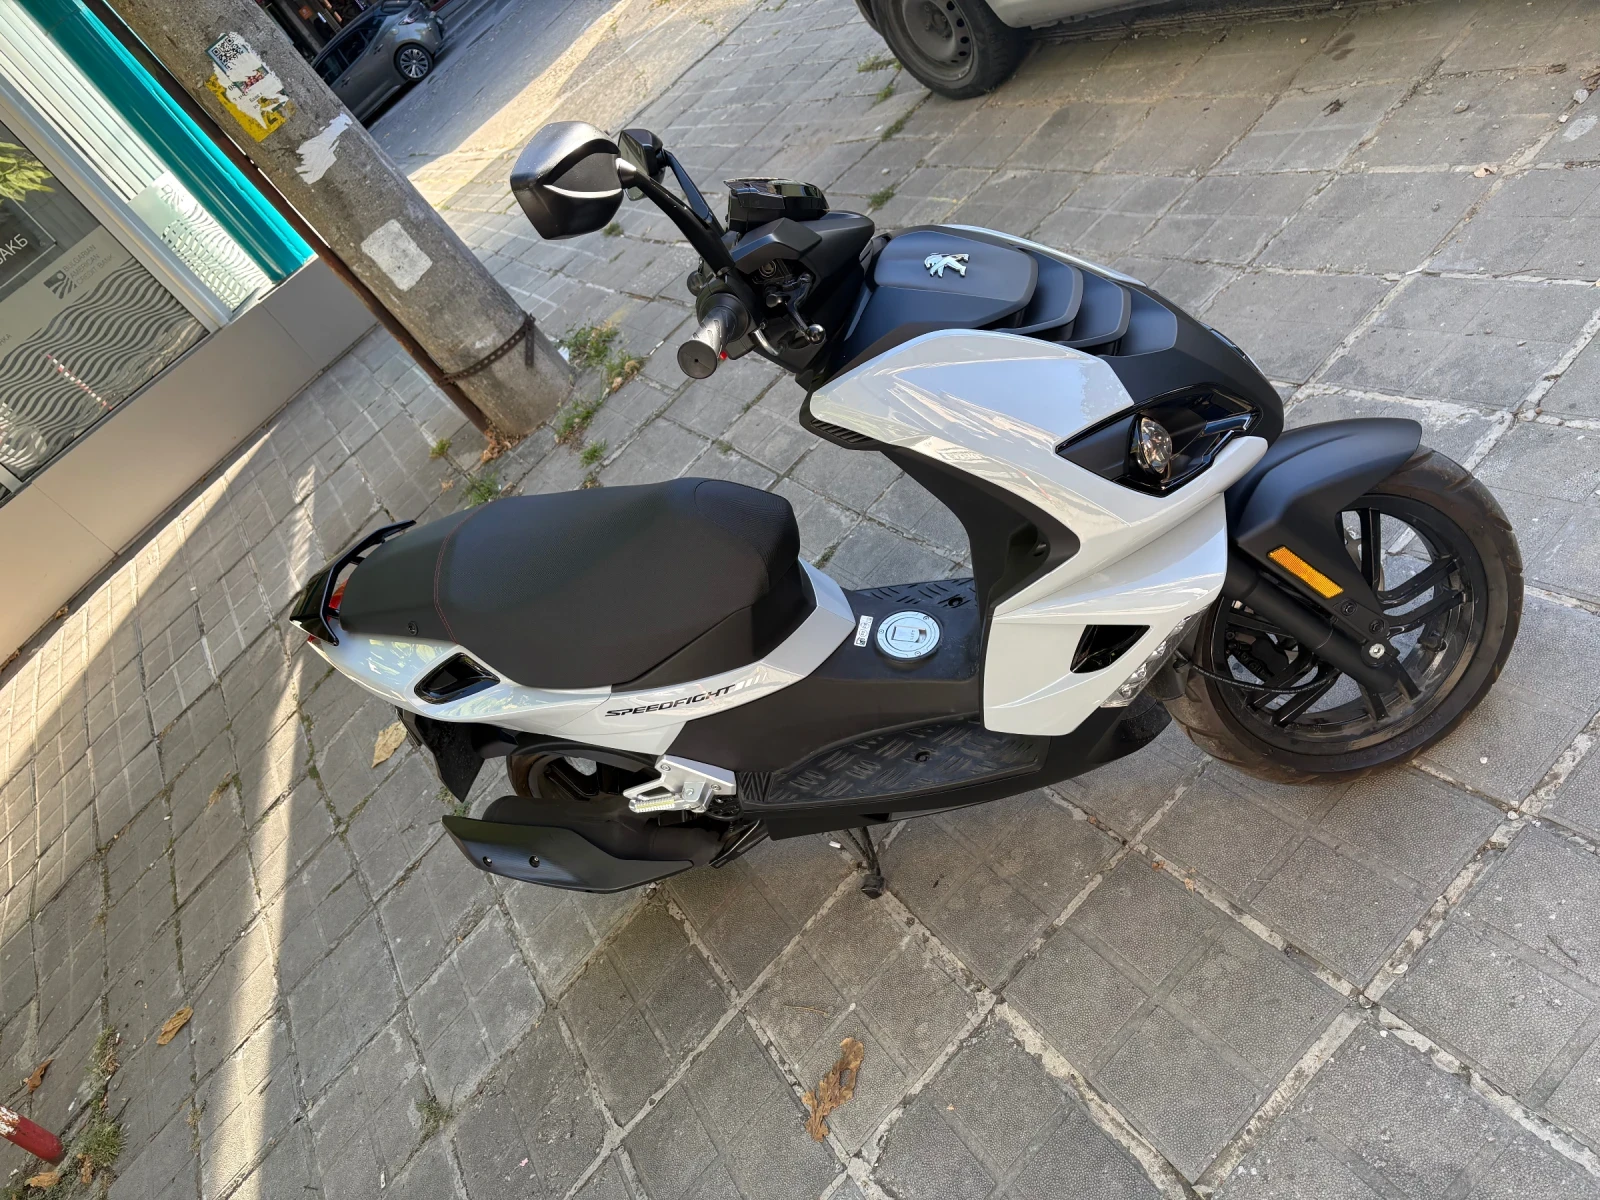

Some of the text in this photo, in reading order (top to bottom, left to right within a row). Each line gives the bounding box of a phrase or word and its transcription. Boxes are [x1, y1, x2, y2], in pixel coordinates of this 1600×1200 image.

[63, 244, 97, 272] BULGARIAN
[70, 253, 100, 279] AMERICAN
[76, 253, 113, 285] CREDIT BANK
[604, 683, 736, 717] SPEEDFIGHT
